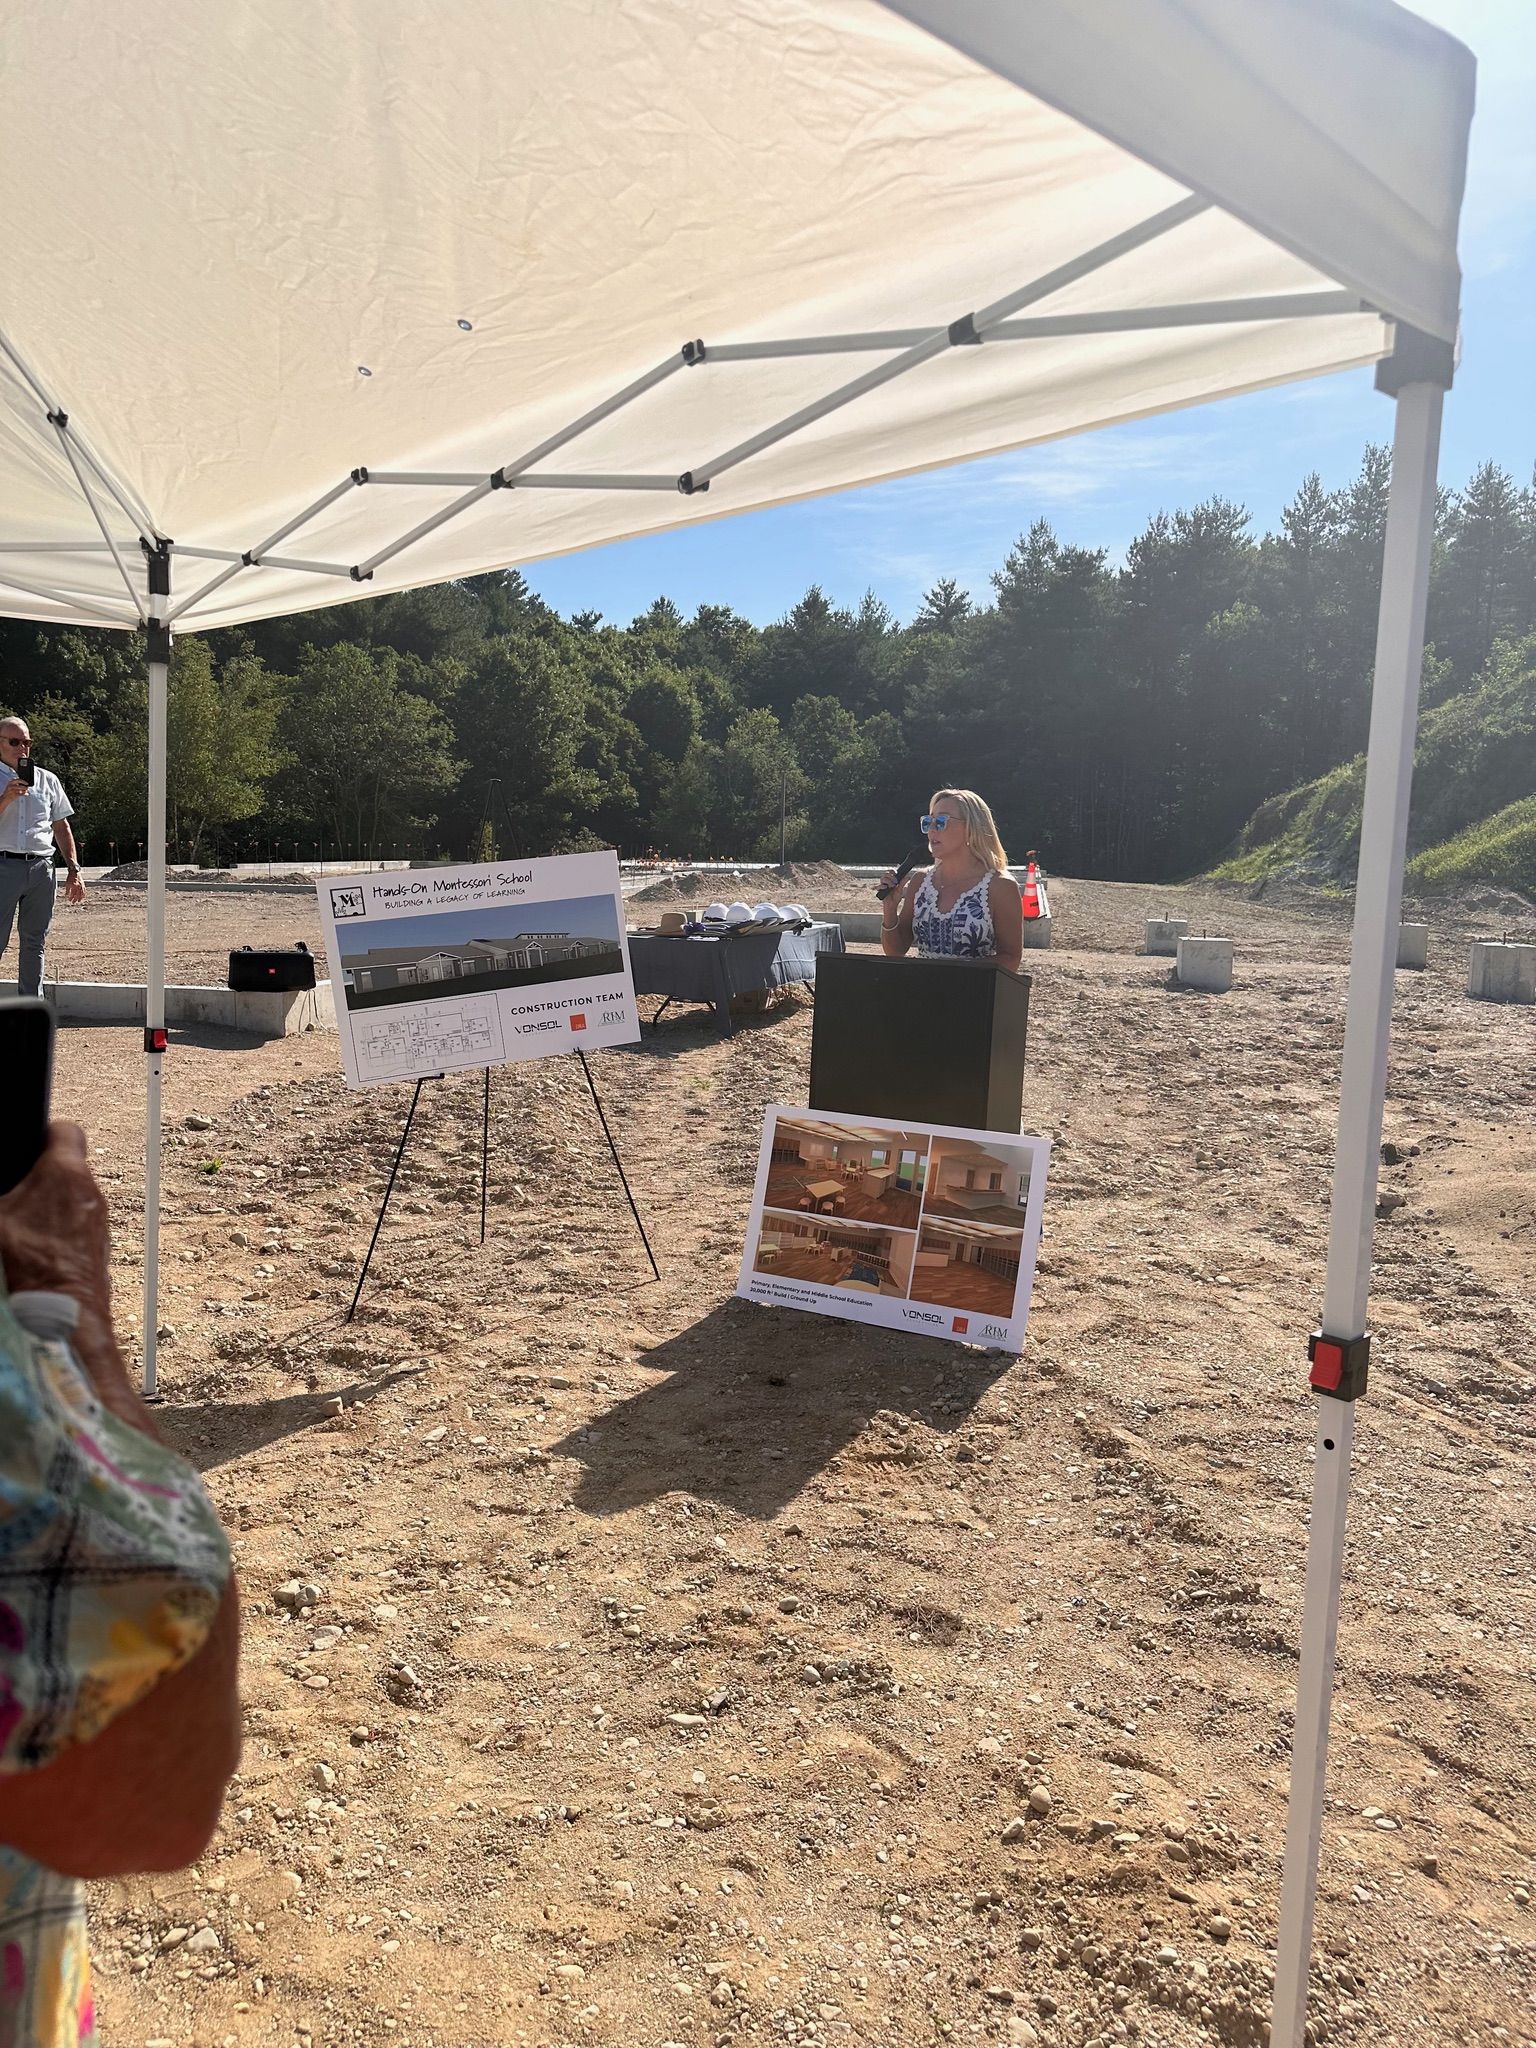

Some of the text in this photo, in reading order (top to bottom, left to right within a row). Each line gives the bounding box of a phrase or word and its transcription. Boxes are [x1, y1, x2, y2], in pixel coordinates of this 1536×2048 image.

[373, 870, 532, 898] Hands-On Montessori School
[385, 898, 423, 909] BUILDING
[435, 894, 469, 904] LEGACY
[472, 891, 484, 900] OF
[486, 888, 525, 898] LEARNING
[510, 992, 624, 1016] CONSTRUCTION TEAM
[514, 1020, 562, 1034] VONSOL
[751, 1279, 771, 1289] Primary,
[772, 1283, 800, 1294] Elementary
[811, 1290, 828, 1298] Middle
[829, 1294, 846, 1302] School
[846, 1297, 873, 1307] Education
[774, 1291, 787, 1299] Build
[790, 1294, 808, 1302] Ground
[902, 1308, 944, 1325] VONSOL
